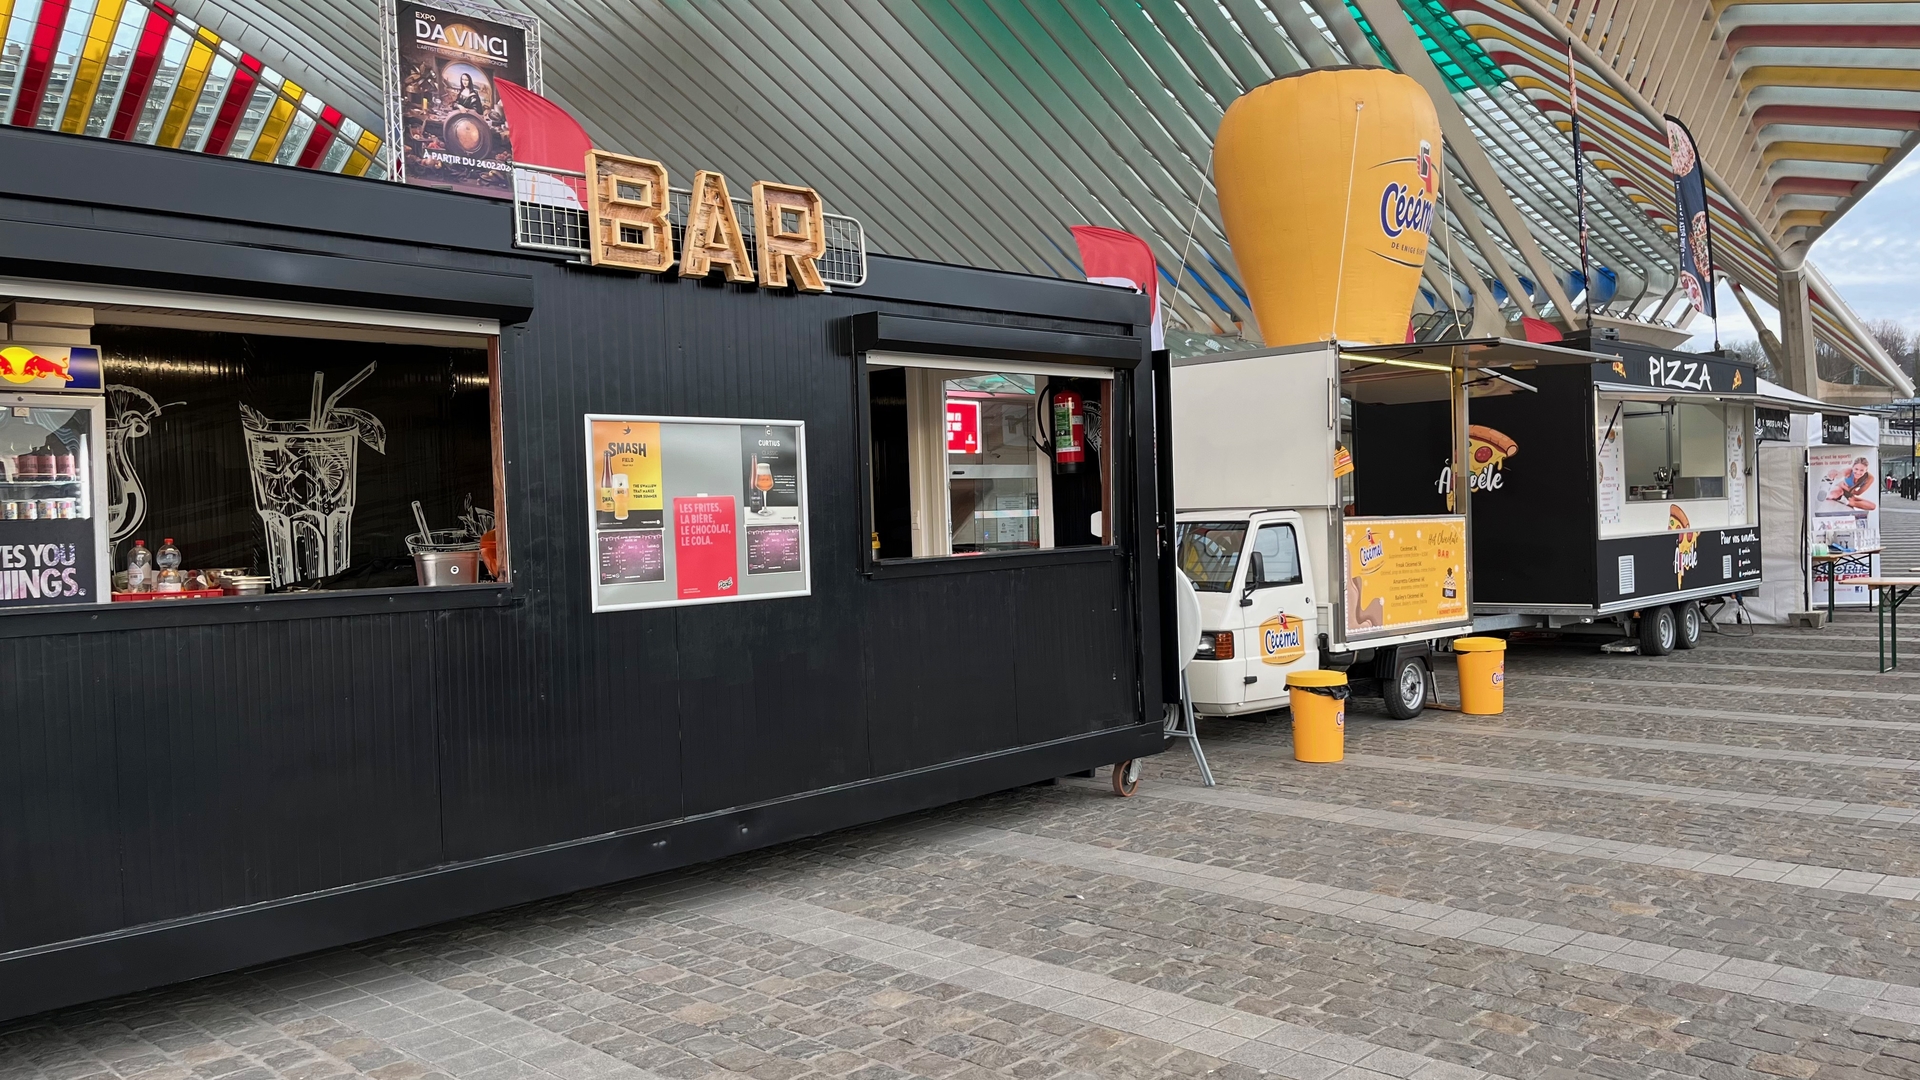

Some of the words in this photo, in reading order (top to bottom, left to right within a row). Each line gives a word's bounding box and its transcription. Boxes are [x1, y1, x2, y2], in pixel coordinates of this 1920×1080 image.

[415, 11, 436, 22] EXPO
[415, 19, 448, 43] DA
[451, 27, 508, 57] VINCI
[423, 148, 430, 159] À
[432, 151, 461, 164] PARTIR
[462, 157, 476, 167] DU
[584, 149, 826, 292] BAR
[1391, 241, 1400, 250] DE
[1401, 244, 1416, 254] ENIGE
[1649, 355, 1712, 392] PIZZA
[608, 442, 647, 458] SMASH
[680, 503, 693, 513] LES
[694, 503, 722, 513] FRITES,
[681, 515, 690, 524] LA
[691, 512, 716, 525] BIÈRE,
[681, 526, 690, 535] LE
[690, 524, 731, 535] CHOCOLAT,
[681, 537, 690, 546] LE
[691, 536, 714, 546] COLA.
[1720, 531, 1731, 545] Pour
[28, 542, 76, 567] YOU
[1437, 549, 1449, 559] BAR
[1264, 626, 1300, 655] Cécémel
